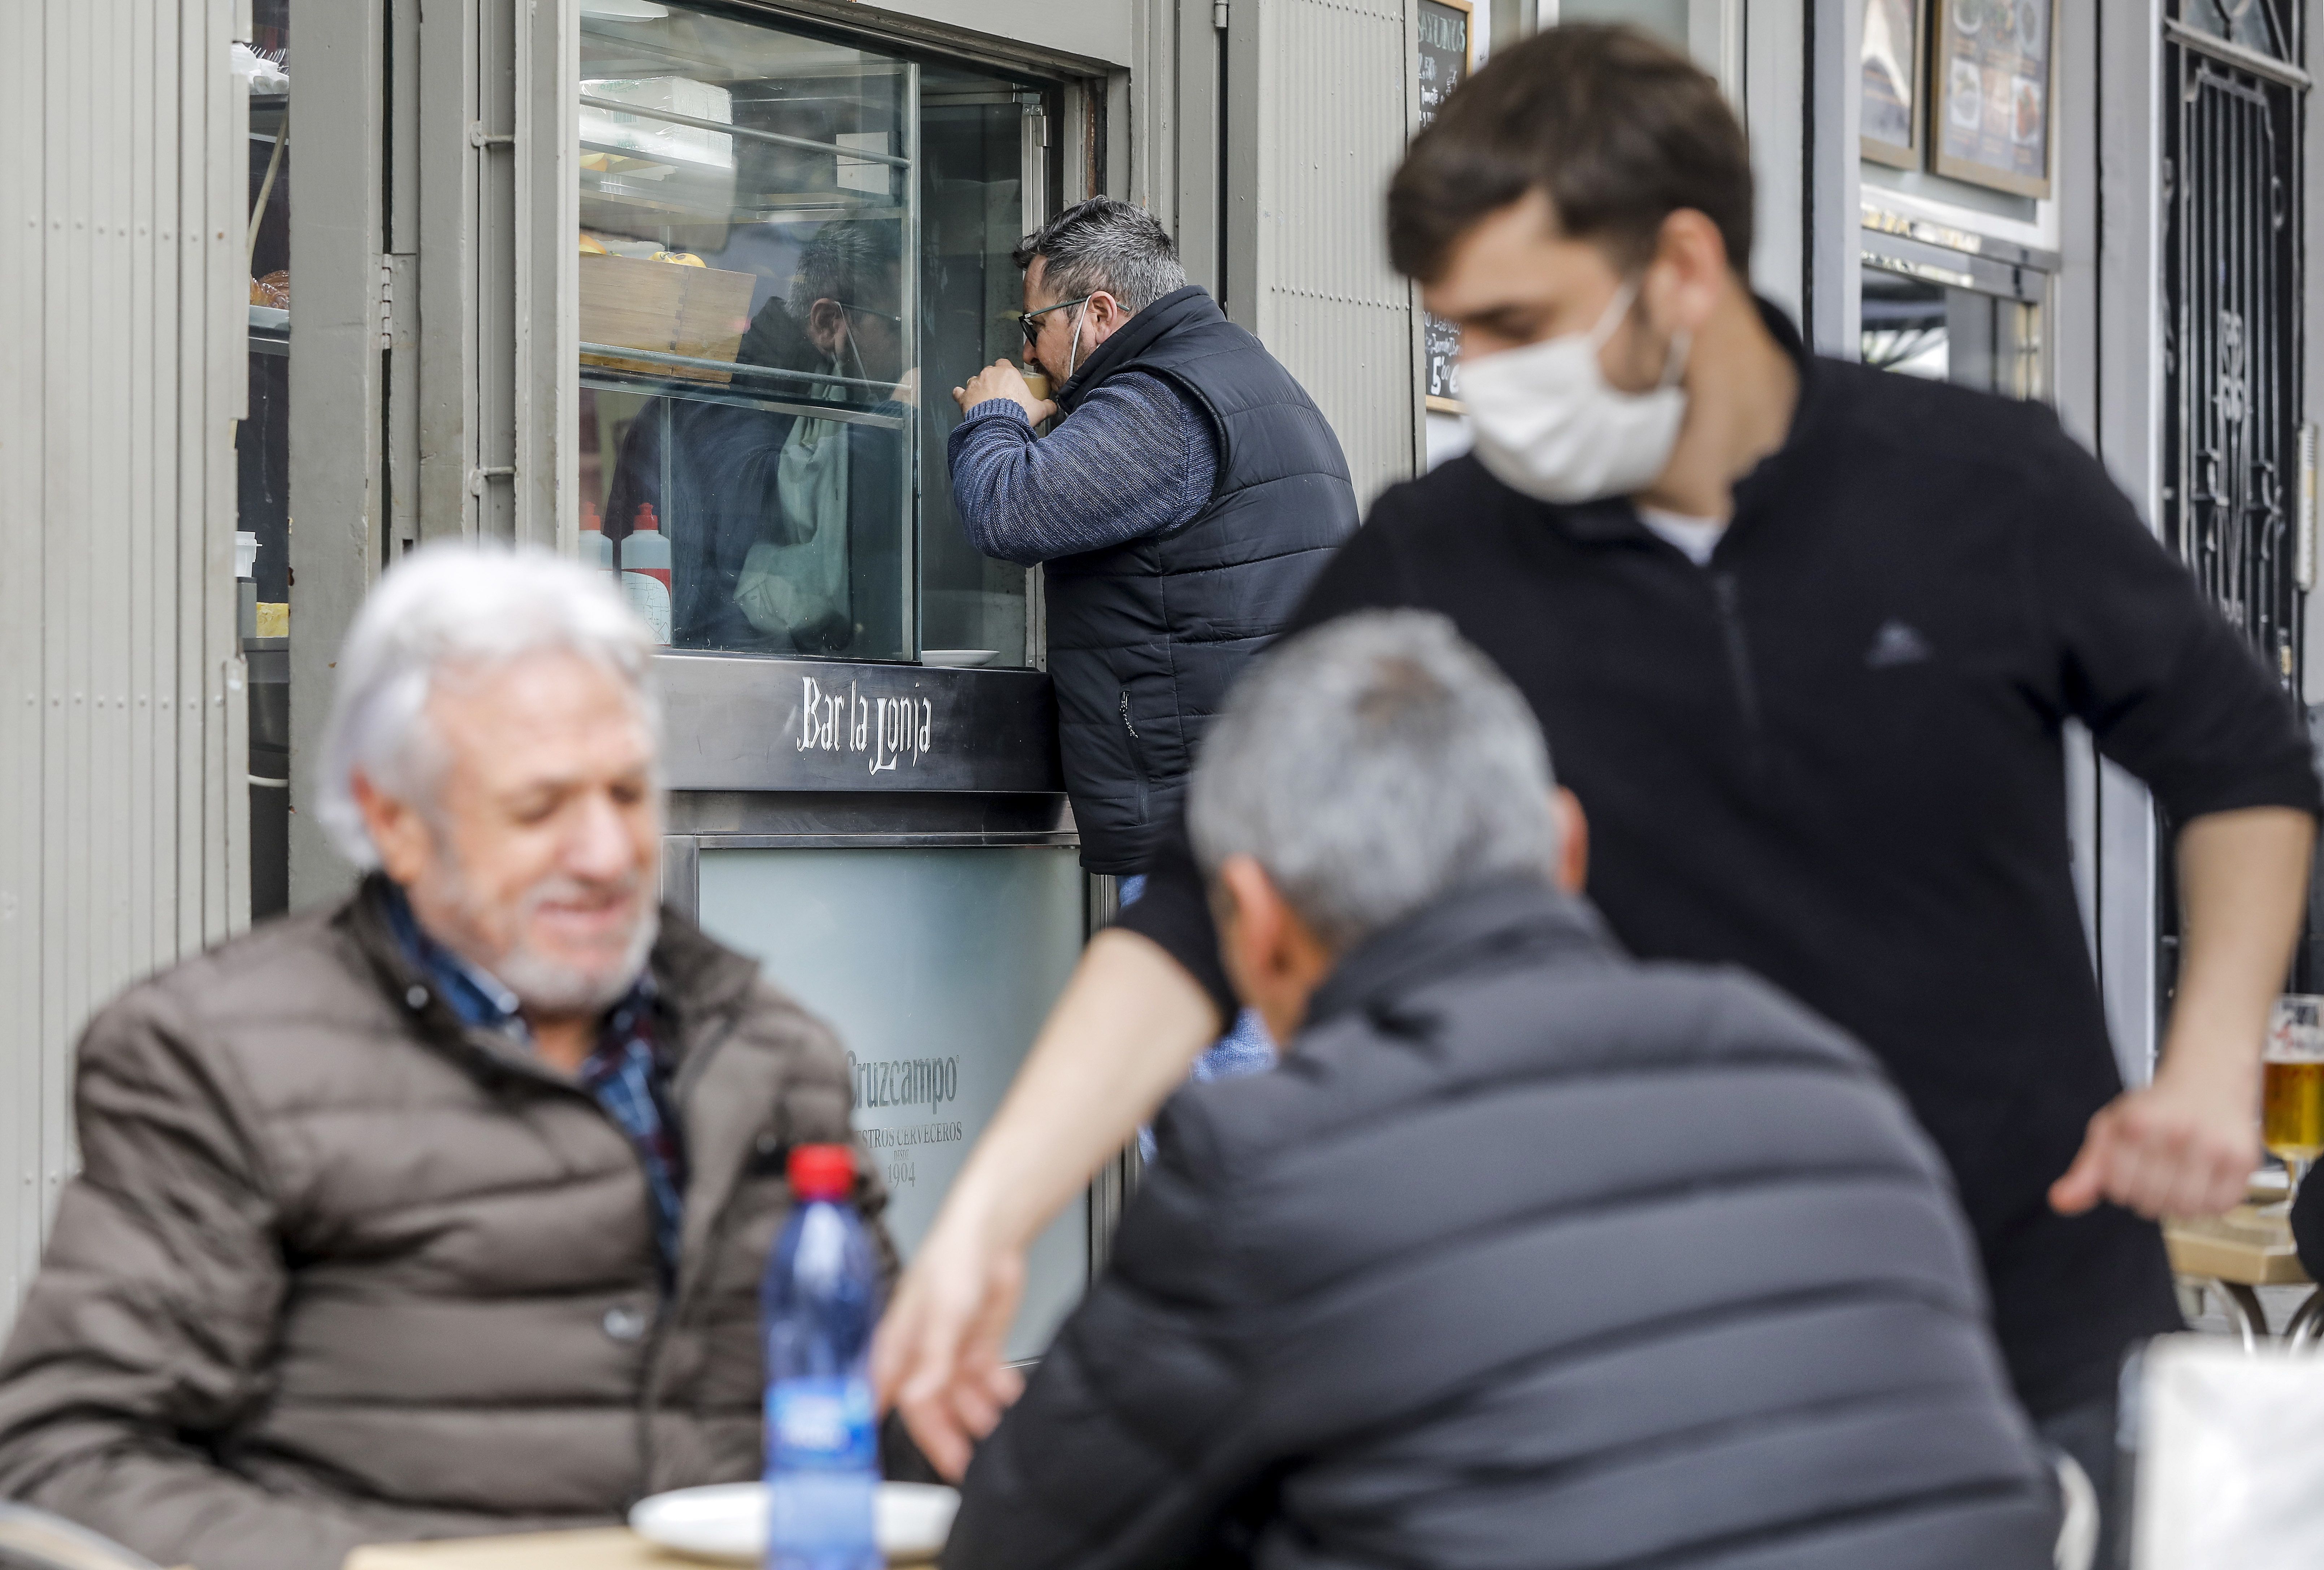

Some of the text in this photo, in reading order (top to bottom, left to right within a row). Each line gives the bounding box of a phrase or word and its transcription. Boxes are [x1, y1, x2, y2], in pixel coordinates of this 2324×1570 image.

[797, 676, 932, 776] Bar la Lonja
[897, 1121, 962, 1146] CERVECEROS
[894, 1149, 909, 1161] DESDE
[887, 1162, 916, 1189] 1904
